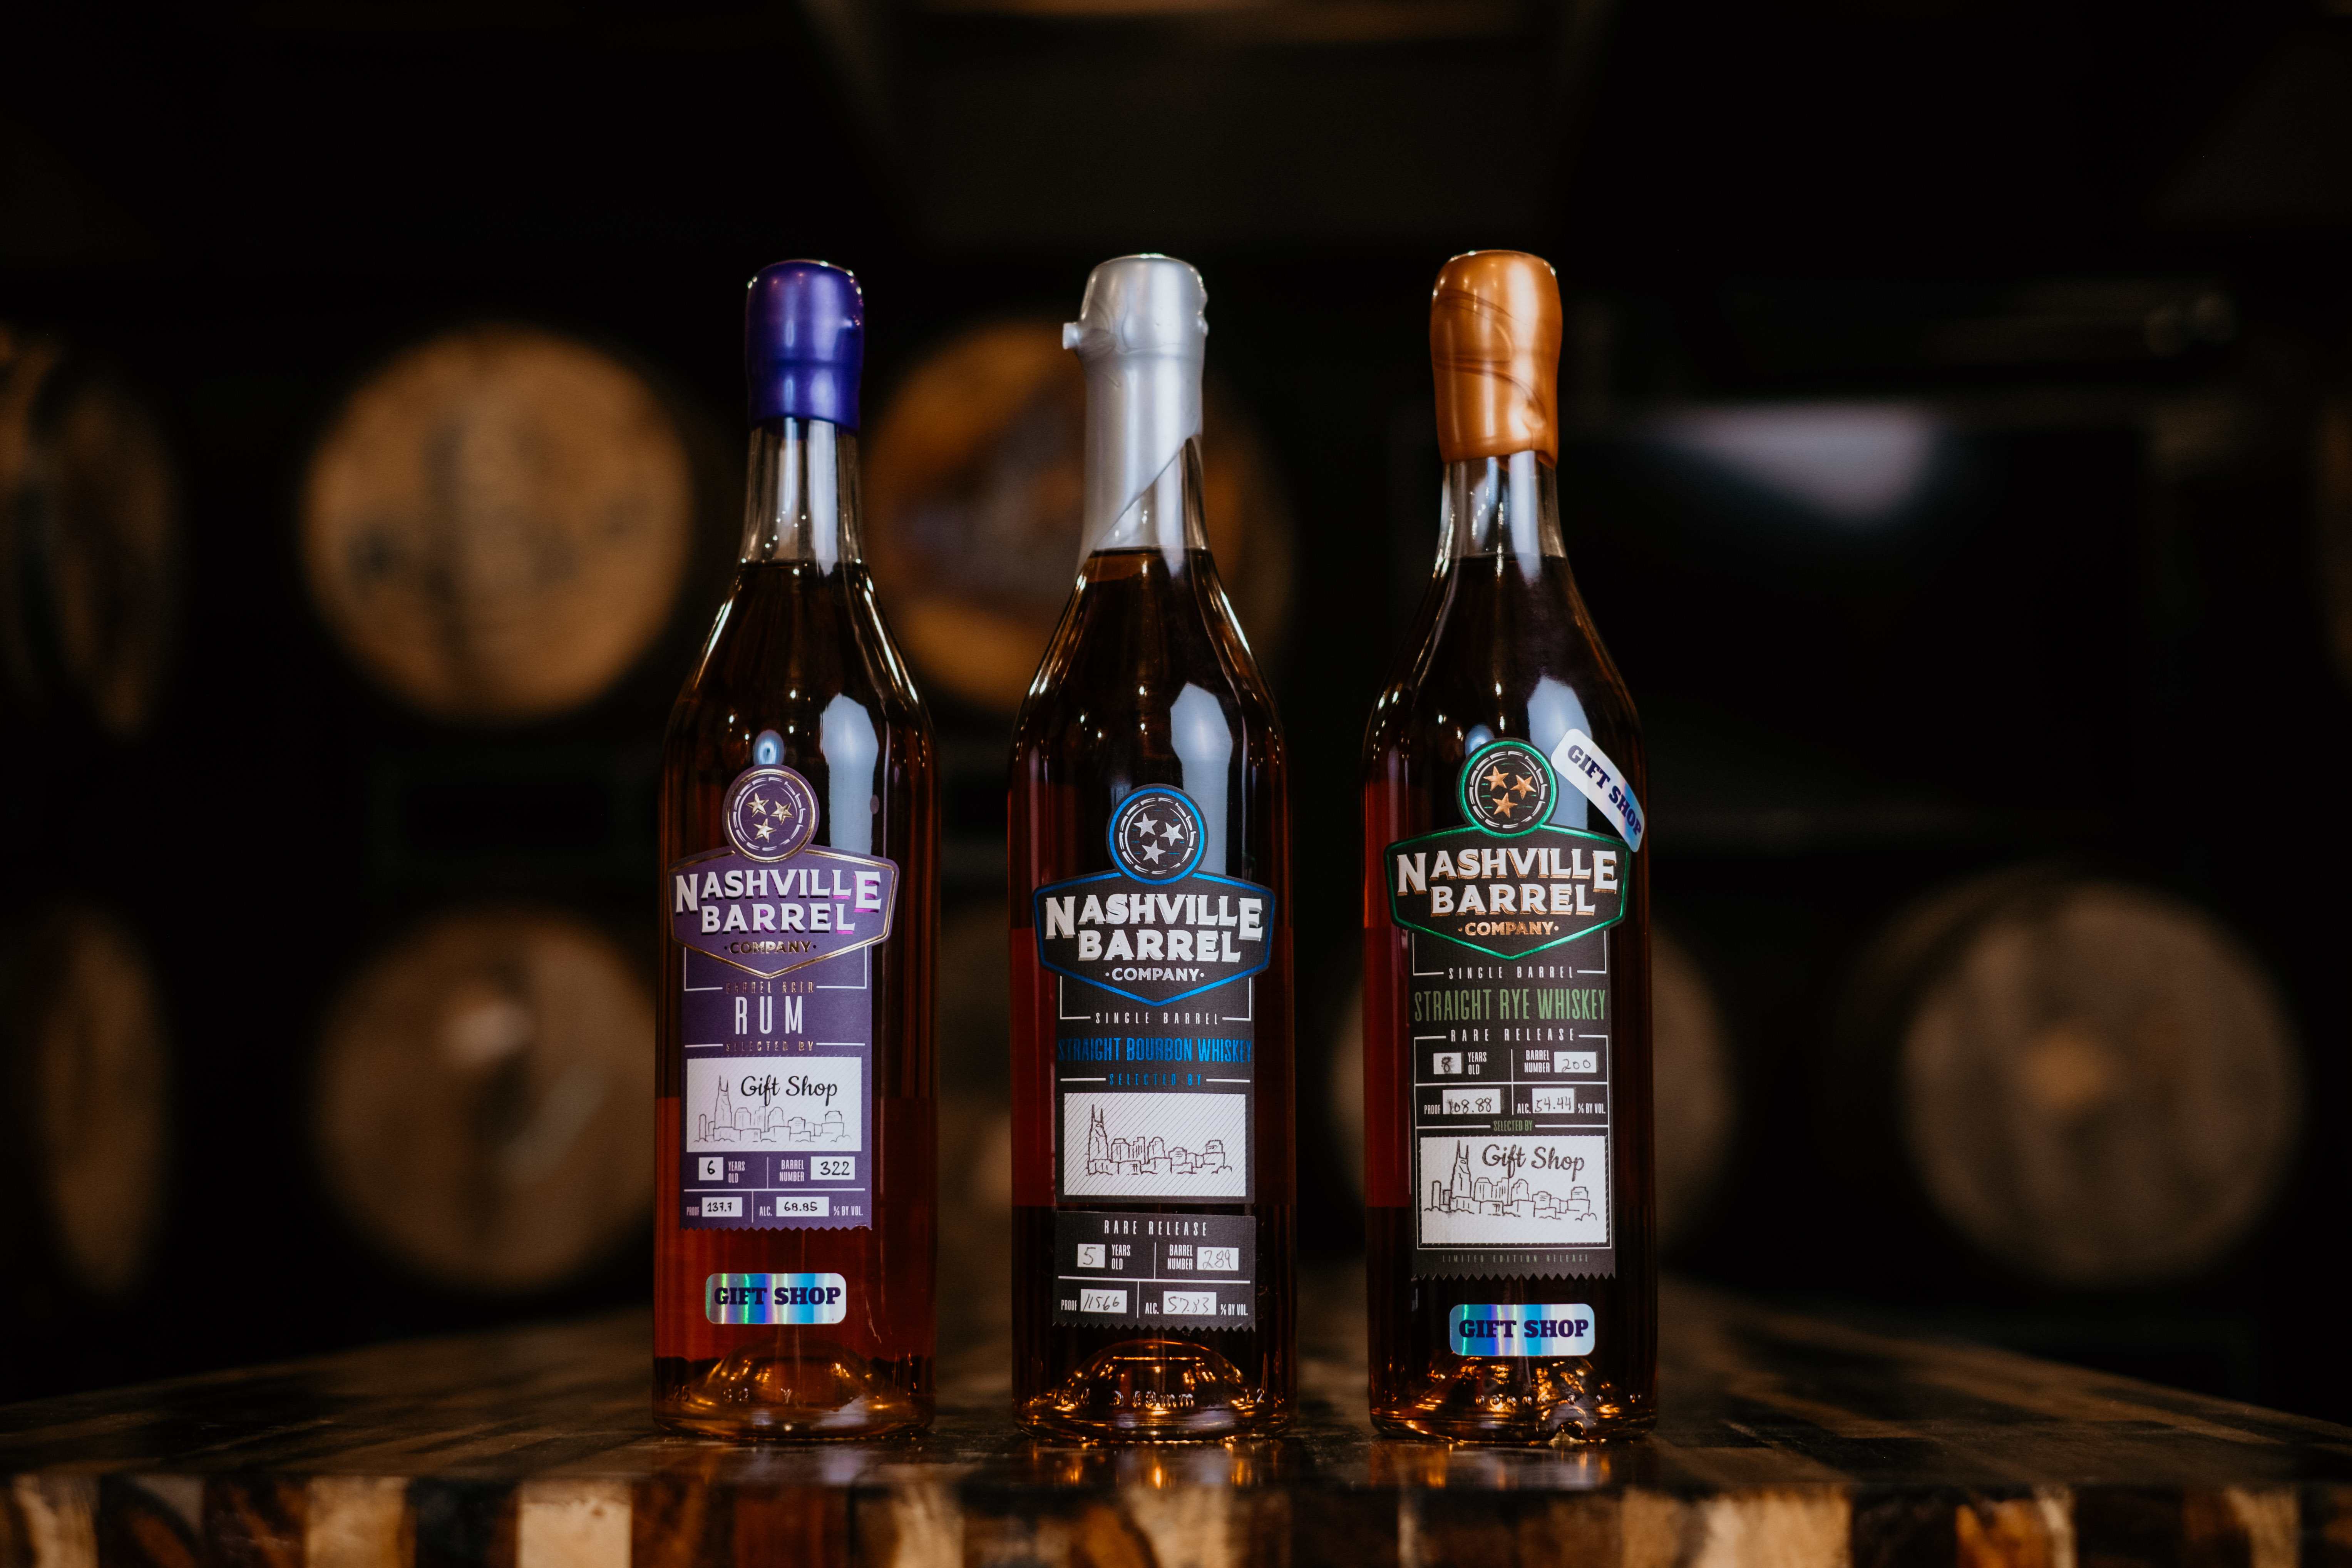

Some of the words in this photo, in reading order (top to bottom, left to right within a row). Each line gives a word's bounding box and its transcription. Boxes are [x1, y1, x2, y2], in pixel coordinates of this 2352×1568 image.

[1567, 745, 1610, 789] GIFT
[1608, 785, 1642, 836] SHOP
[1397, 848, 1618, 896] NASHVILLE
[676, 869, 882, 915] NASHVILLE
[1430, 884, 1595, 917] BARREL
[701, 903, 855, 934] BARREL
[1045, 894, 1263, 941] NASHVILLE
[1465, 921, 1553, 935] COMPANY
[729, 940, 811, 954] COMPANY
[1078, 929, 1241, 962] BARREL
[1112, 967, 1200, 981] COMPANY
[1449, 967, 1502, 979] SINGLE
[1517, 967, 1572, 979] BARREL
[726, 981, 771, 994] BARREL
[1414, 989, 1492, 1022] STRAIGHT
[1499, 989, 1530, 1020] RYE
[1537, 988, 1605, 1020] WHISKEY
[735, 996, 803, 1034] RUM
[1096, 1012, 1149, 1024] SINGLE
[1163, 1012, 1218, 1025] BARREL
[1451, 1029, 1489, 1042] RARE
[1505, 1028, 1574, 1041] RELEASE
[799, 1041, 813, 1051] BY
[1058, 1038, 1121, 1061] STRAIGHT
[1127, 1038, 1192, 1061] BOURBON
[1197, 1038, 1251, 1063] WHISKEY
[1468, 1051, 1487, 1062] YEARS
[1526, 1050, 1550, 1061] BARREL
[1441, 1056, 1453, 1073] 8
[1468, 1064, 1480, 1075] OLD
[1524, 1062, 1550, 1073] NUMBER
[1562, 1058, 1591, 1072] 200
[1109, 1073, 1176, 1086] SELECTED
[1187, 1074, 1201, 1086] BY
[740, 1074, 780, 1107] Gift
[786, 1075, 838, 1107] Shop
[1424, 1104, 1441, 1115] PROOF
[1517, 1103, 1531, 1114] ALC.
[1535, 1096, 1571, 1112] 54.44
[1578, 1103, 1584, 1114] %
[1585, 1103, 1593, 1114] BY
[1595, 1103, 1606, 1114] VOL.
[1493, 1120, 1523, 1131] SELECTED
[1524, 1120, 1533, 1131] BY
[707, 1160, 715, 1175] 6
[728, 1161, 745, 1171] YEARS
[781, 1160, 804, 1170] BARREL
[820, 1161, 850, 1176] 322
[1482, 1143, 1526, 1178] Gift
[1531, 1146, 1585, 1181] Shop
[728, 1173, 738, 1183] OLD
[779, 1171, 804, 1182] NUMBER
[686, 1207, 699, 1216] PROOF
[707, 1202, 732, 1212] 137.7
[759, 1206, 772, 1216] ALC.
[784, 1201, 818, 1212] 68.85
[834, 1206, 840, 1216] %
[842, 1206, 849, 1216] BY
[851, 1206, 863, 1216] VOL.
[1104, 1220, 1137, 1234] RARE
[1148, 1221, 1207, 1237] RELEASE
[1083, 1247, 1096, 1266] 5
[1111, 1244, 1131, 1256] YEARS
[1169, 1244, 1193, 1256] BARREL
[1112, 1258, 1123, 1270] OLD
[1167, 1258, 1193, 1270] NUMBER
[1202, 1249, 1232, 1269] 289
[1442, 1255, 1483, 1263] LIMITED
[1493, 1255, 1537, 1263] EDITION
[1547, 1254, 1588, 1262] RELEASE
[714, 1287, 768, 1305] GIFT
[774, 1287, 841, 1305] SHOP
[1061, 1299, 1077, 1311] PROOF
[1145, 1302, 1159, 1314] ALC.
[1220, 1304, 1226, 1315] %
[1228, 1304, 1236, 1315] BY
[1237, 1304, 1248, 1315] VOL.
[1459, 1319, 1517, 1338] GIFT
[1524, 1319, 1589, 1338] SHOP
